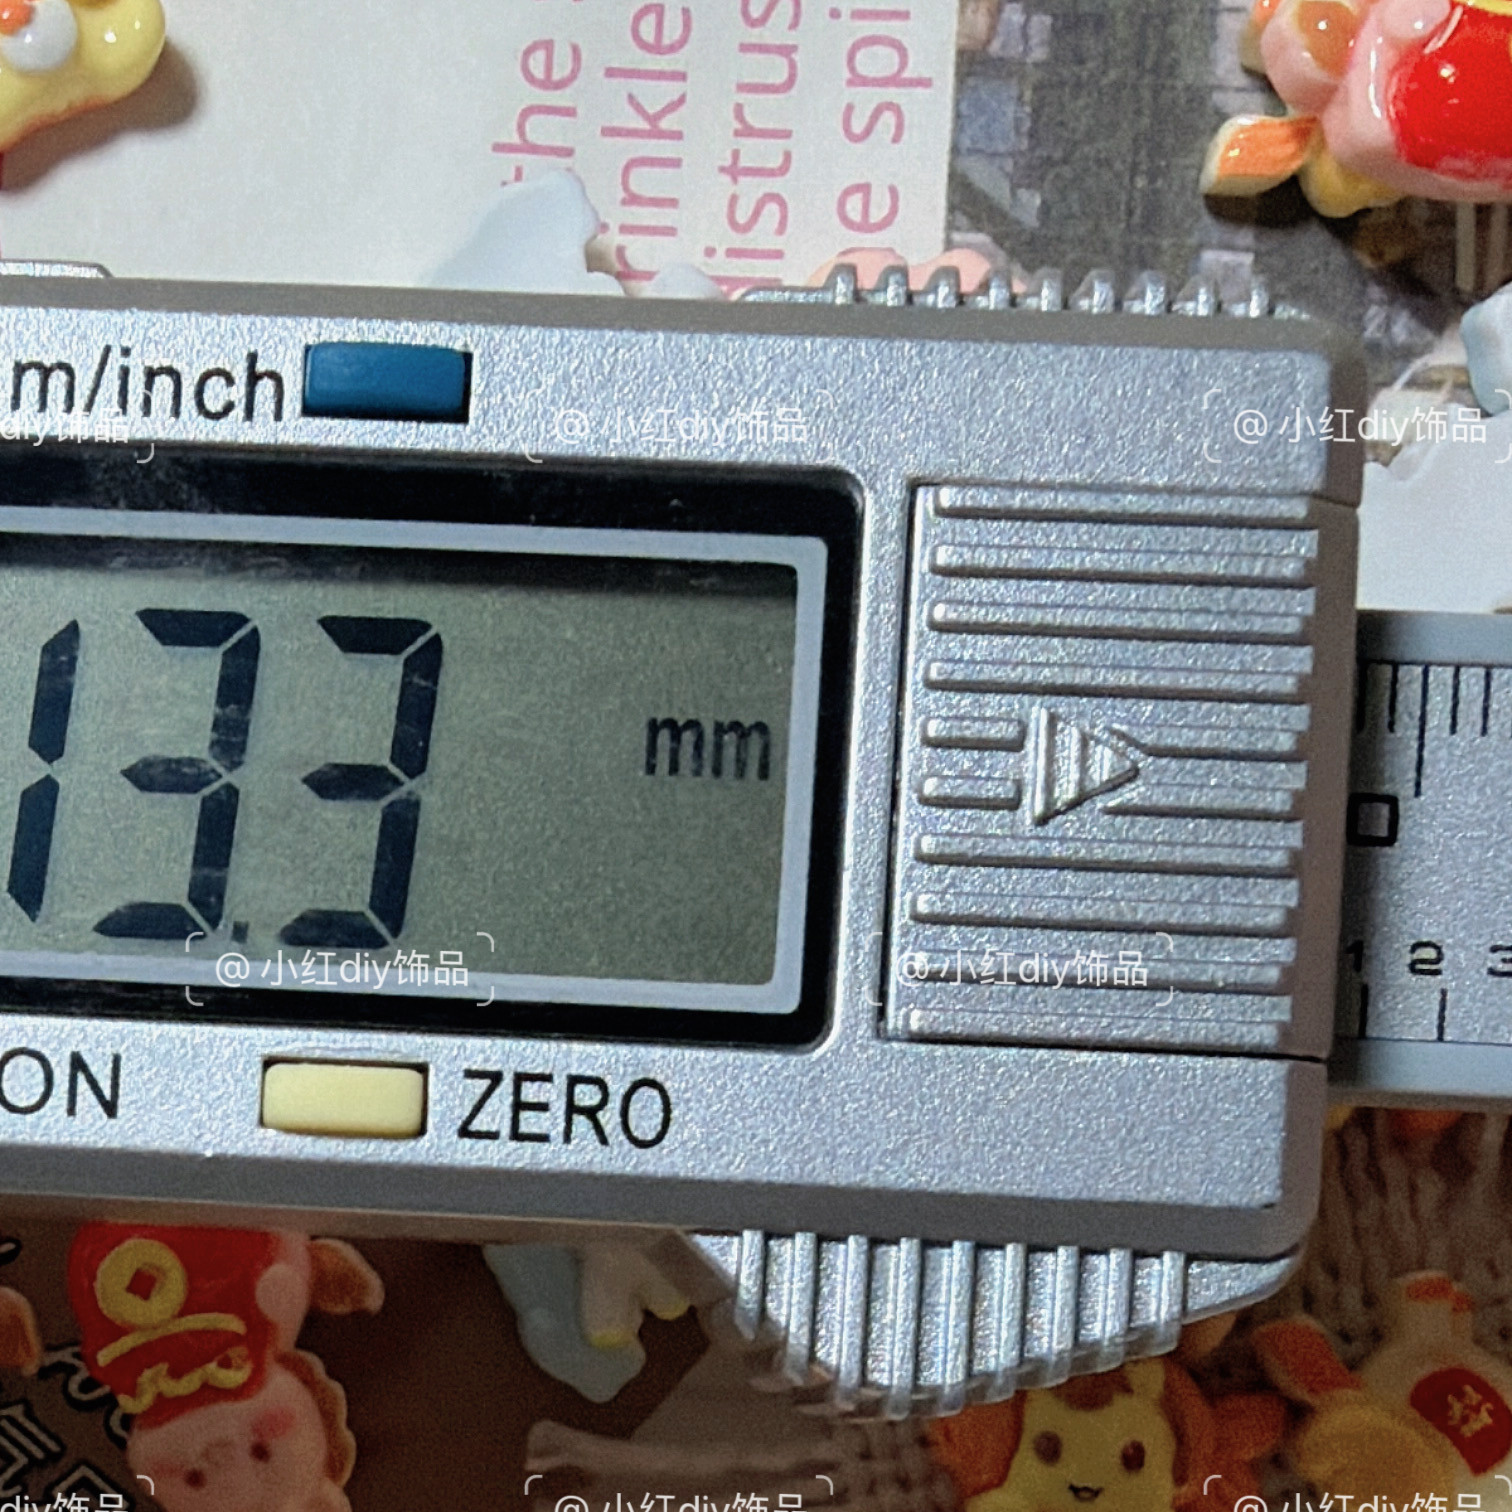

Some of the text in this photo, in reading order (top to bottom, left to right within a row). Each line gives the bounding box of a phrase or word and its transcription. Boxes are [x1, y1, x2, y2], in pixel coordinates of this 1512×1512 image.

[6, 606, 773, 950] 13.3 mm
[1345, 939, 1365, 974] 1
[1407, 940, 1444, 976] 2
[457, 1068, 675, 1151] ZERO
